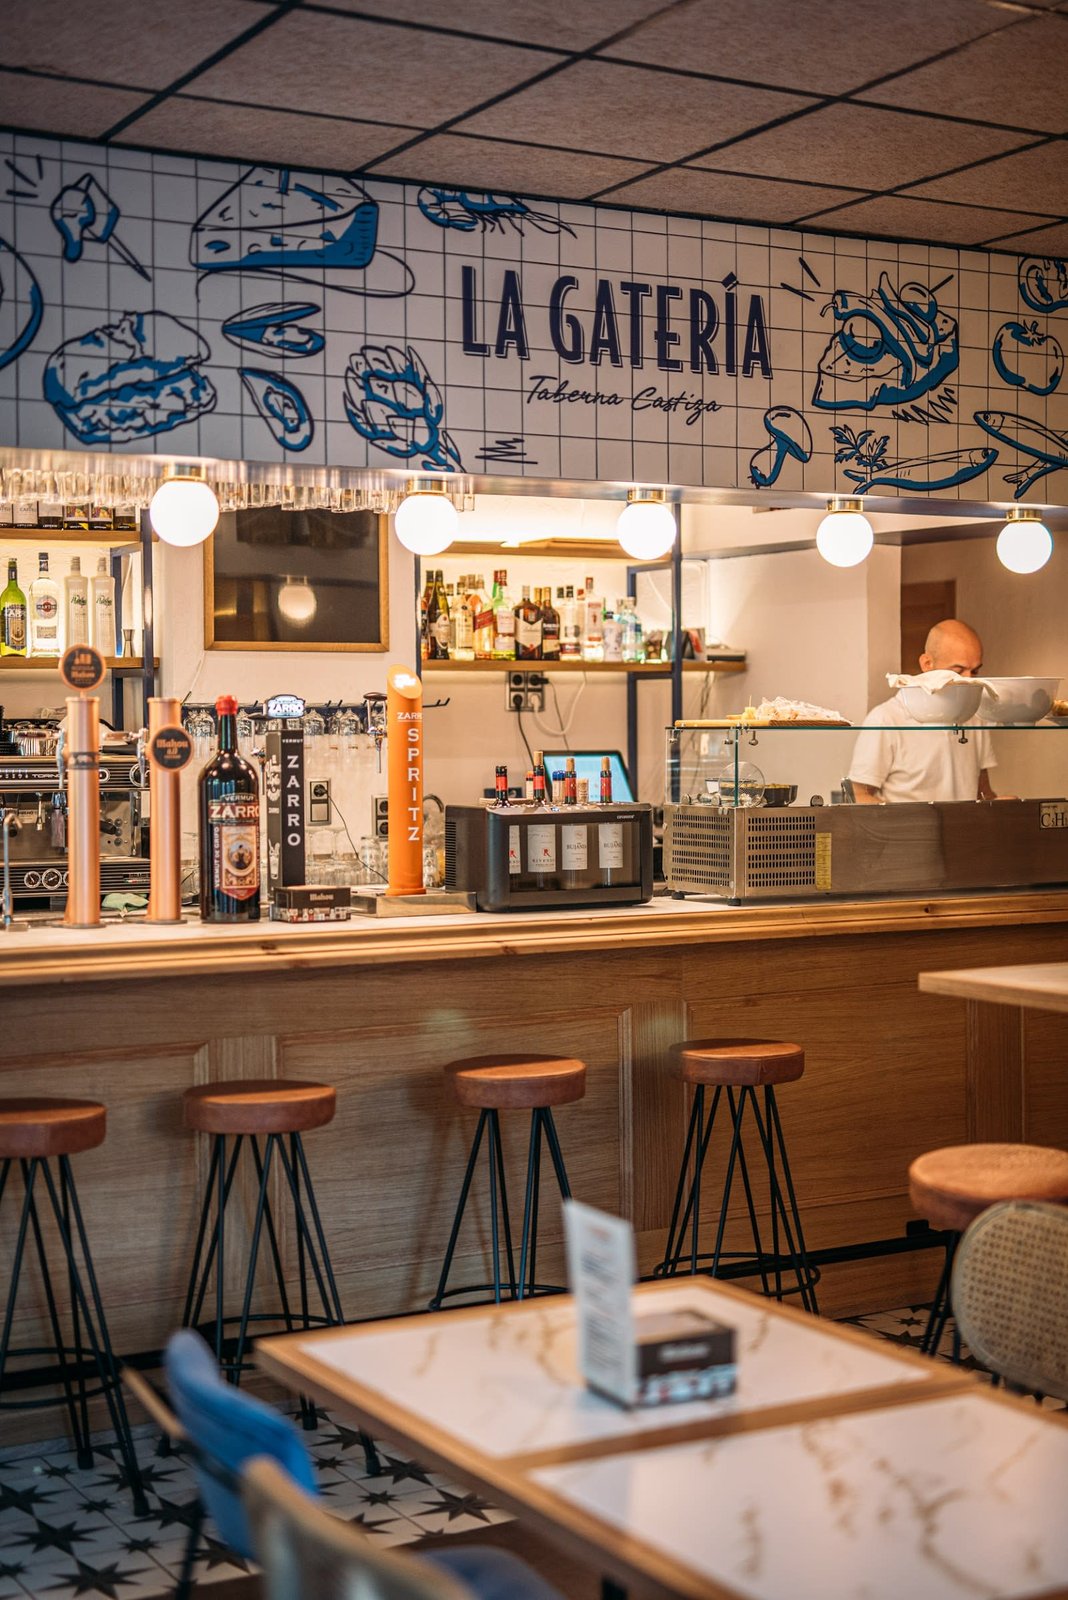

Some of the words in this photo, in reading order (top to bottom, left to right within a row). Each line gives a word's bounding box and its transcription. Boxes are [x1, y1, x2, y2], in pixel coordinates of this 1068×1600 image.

[461, 265, 530, 360] LA
[549, 271, 774, 379] GATERÍA
[526, 375, 624, 405] Taberna
[631, 387, 722, 426] Castiza
[268, 703, 304, 713] ZARRO
[396, 711, 422, 719] ZARR
[286, 755, 301, 846] ZARRO
[407, 727, 420, 841] SPRITZ
